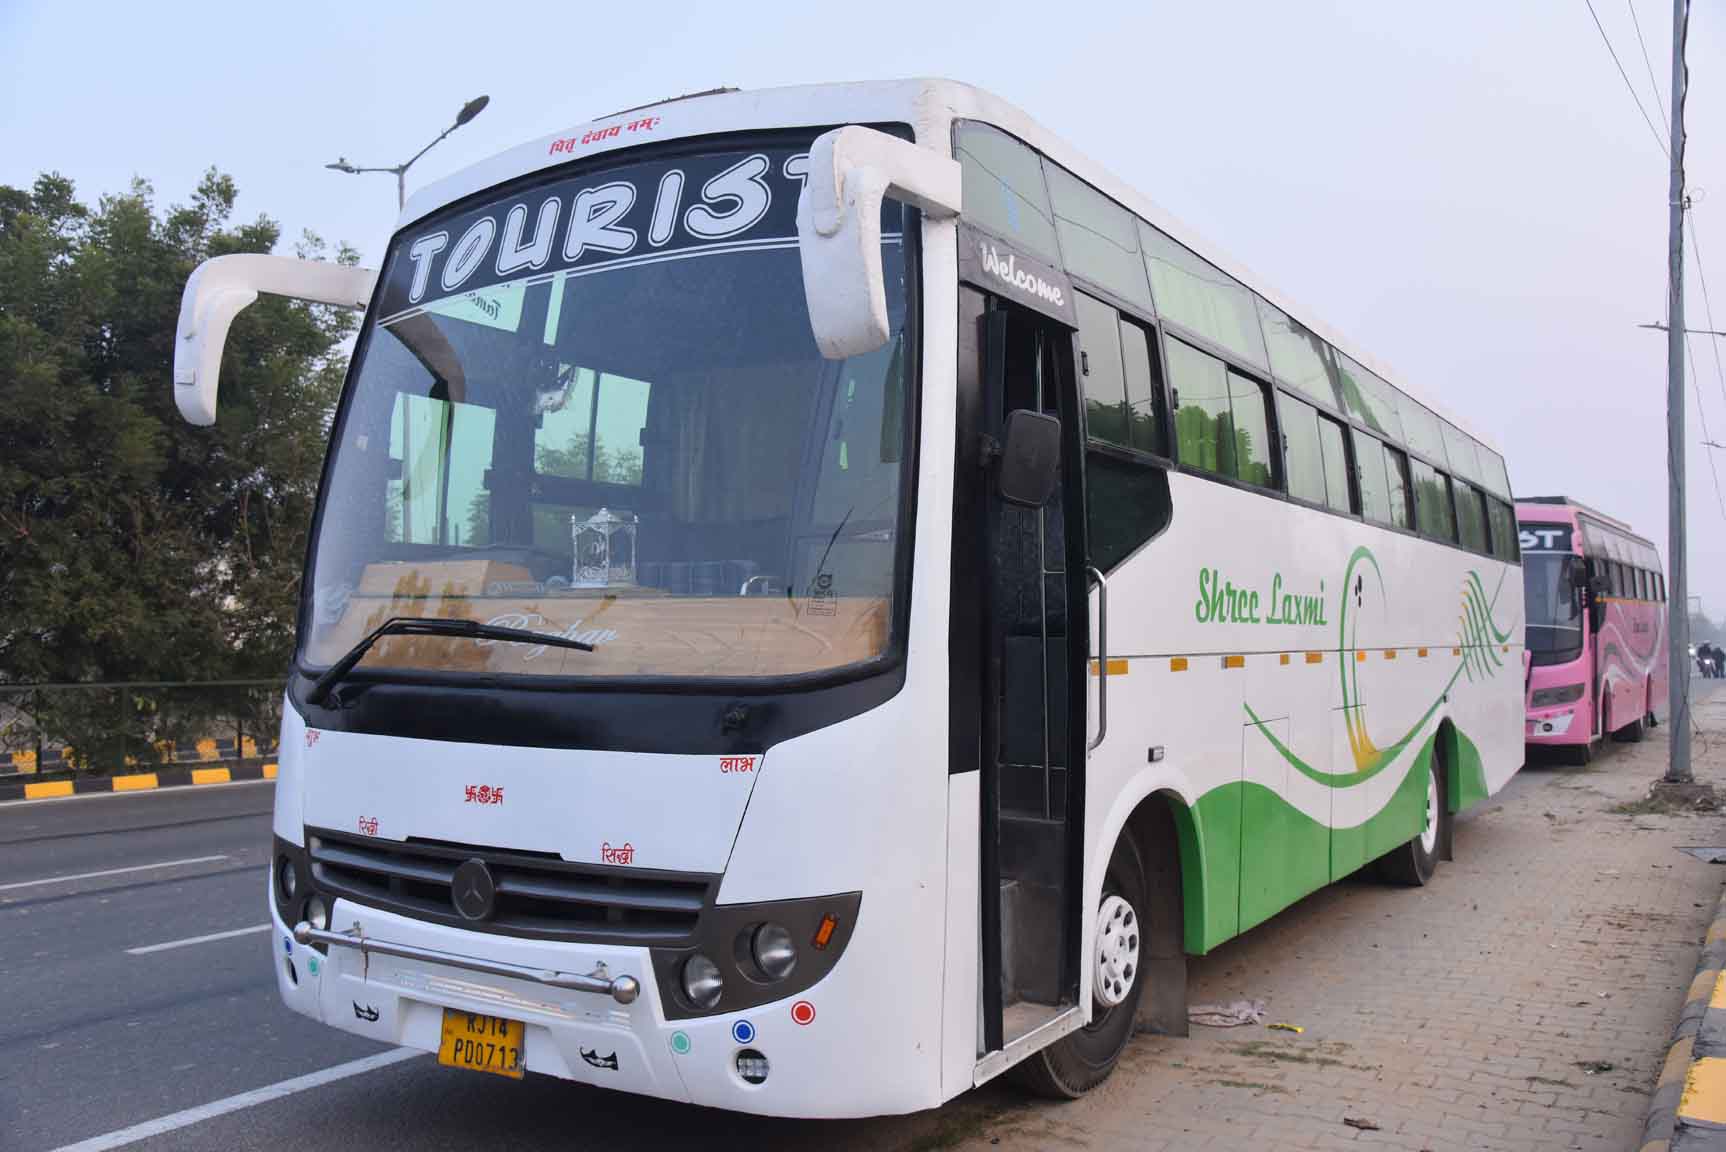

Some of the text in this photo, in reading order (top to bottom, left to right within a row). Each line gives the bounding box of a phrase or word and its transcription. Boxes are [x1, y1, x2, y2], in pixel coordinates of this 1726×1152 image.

[980, 243, 1065, 306] Welcome
[1195, 567, 1328, 625] Shree Laxmi
[719, 757, 756, 774] लाभ
[453, 1038, 520, 1070] PD0713
